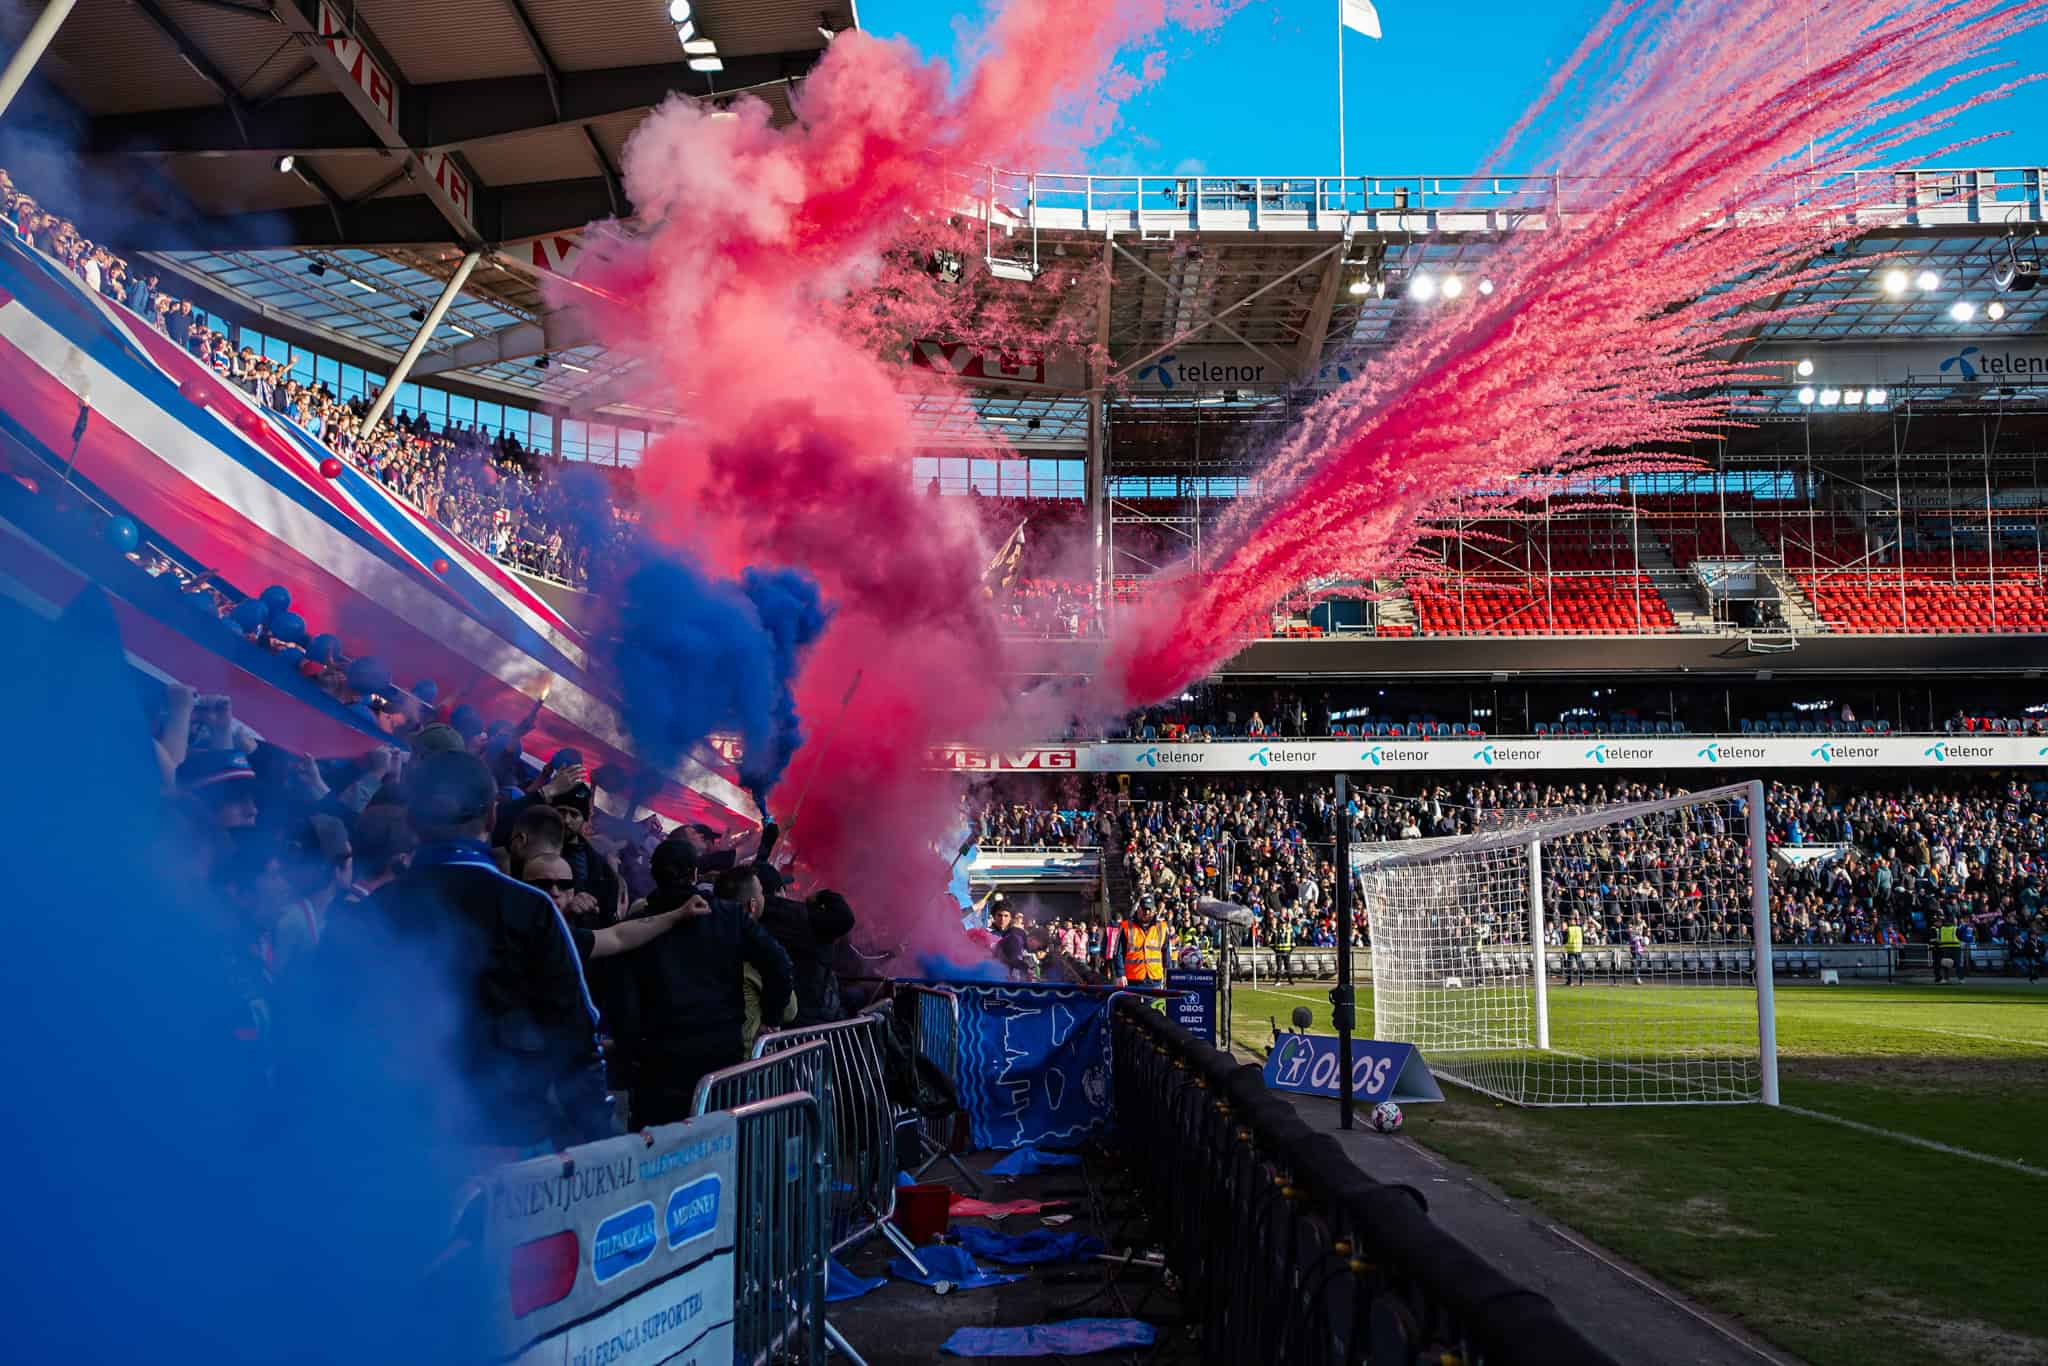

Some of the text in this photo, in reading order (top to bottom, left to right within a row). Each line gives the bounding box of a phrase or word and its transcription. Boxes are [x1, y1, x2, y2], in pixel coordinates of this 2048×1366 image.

[917, 340, 1039, 381] VG
[1177, 361, 1265, 383] telenor
[1156, 750, 1205, 763] telenor
[1268, 750, 1317, 762] telenor
[1380, 749, 1429, 761] telenor
[1492, 748, 1541, 761] telenor
[1605, 747, 1654, 760] telenor
[1717, 746, 1766, 759] telenor
[1830, 745, 1880, 758] telenor
[1943, 744, 1994, 758] telenor
[1004, 751, 1072, 768] VG
[1180, 1015, 1203, 1024] SELECT
